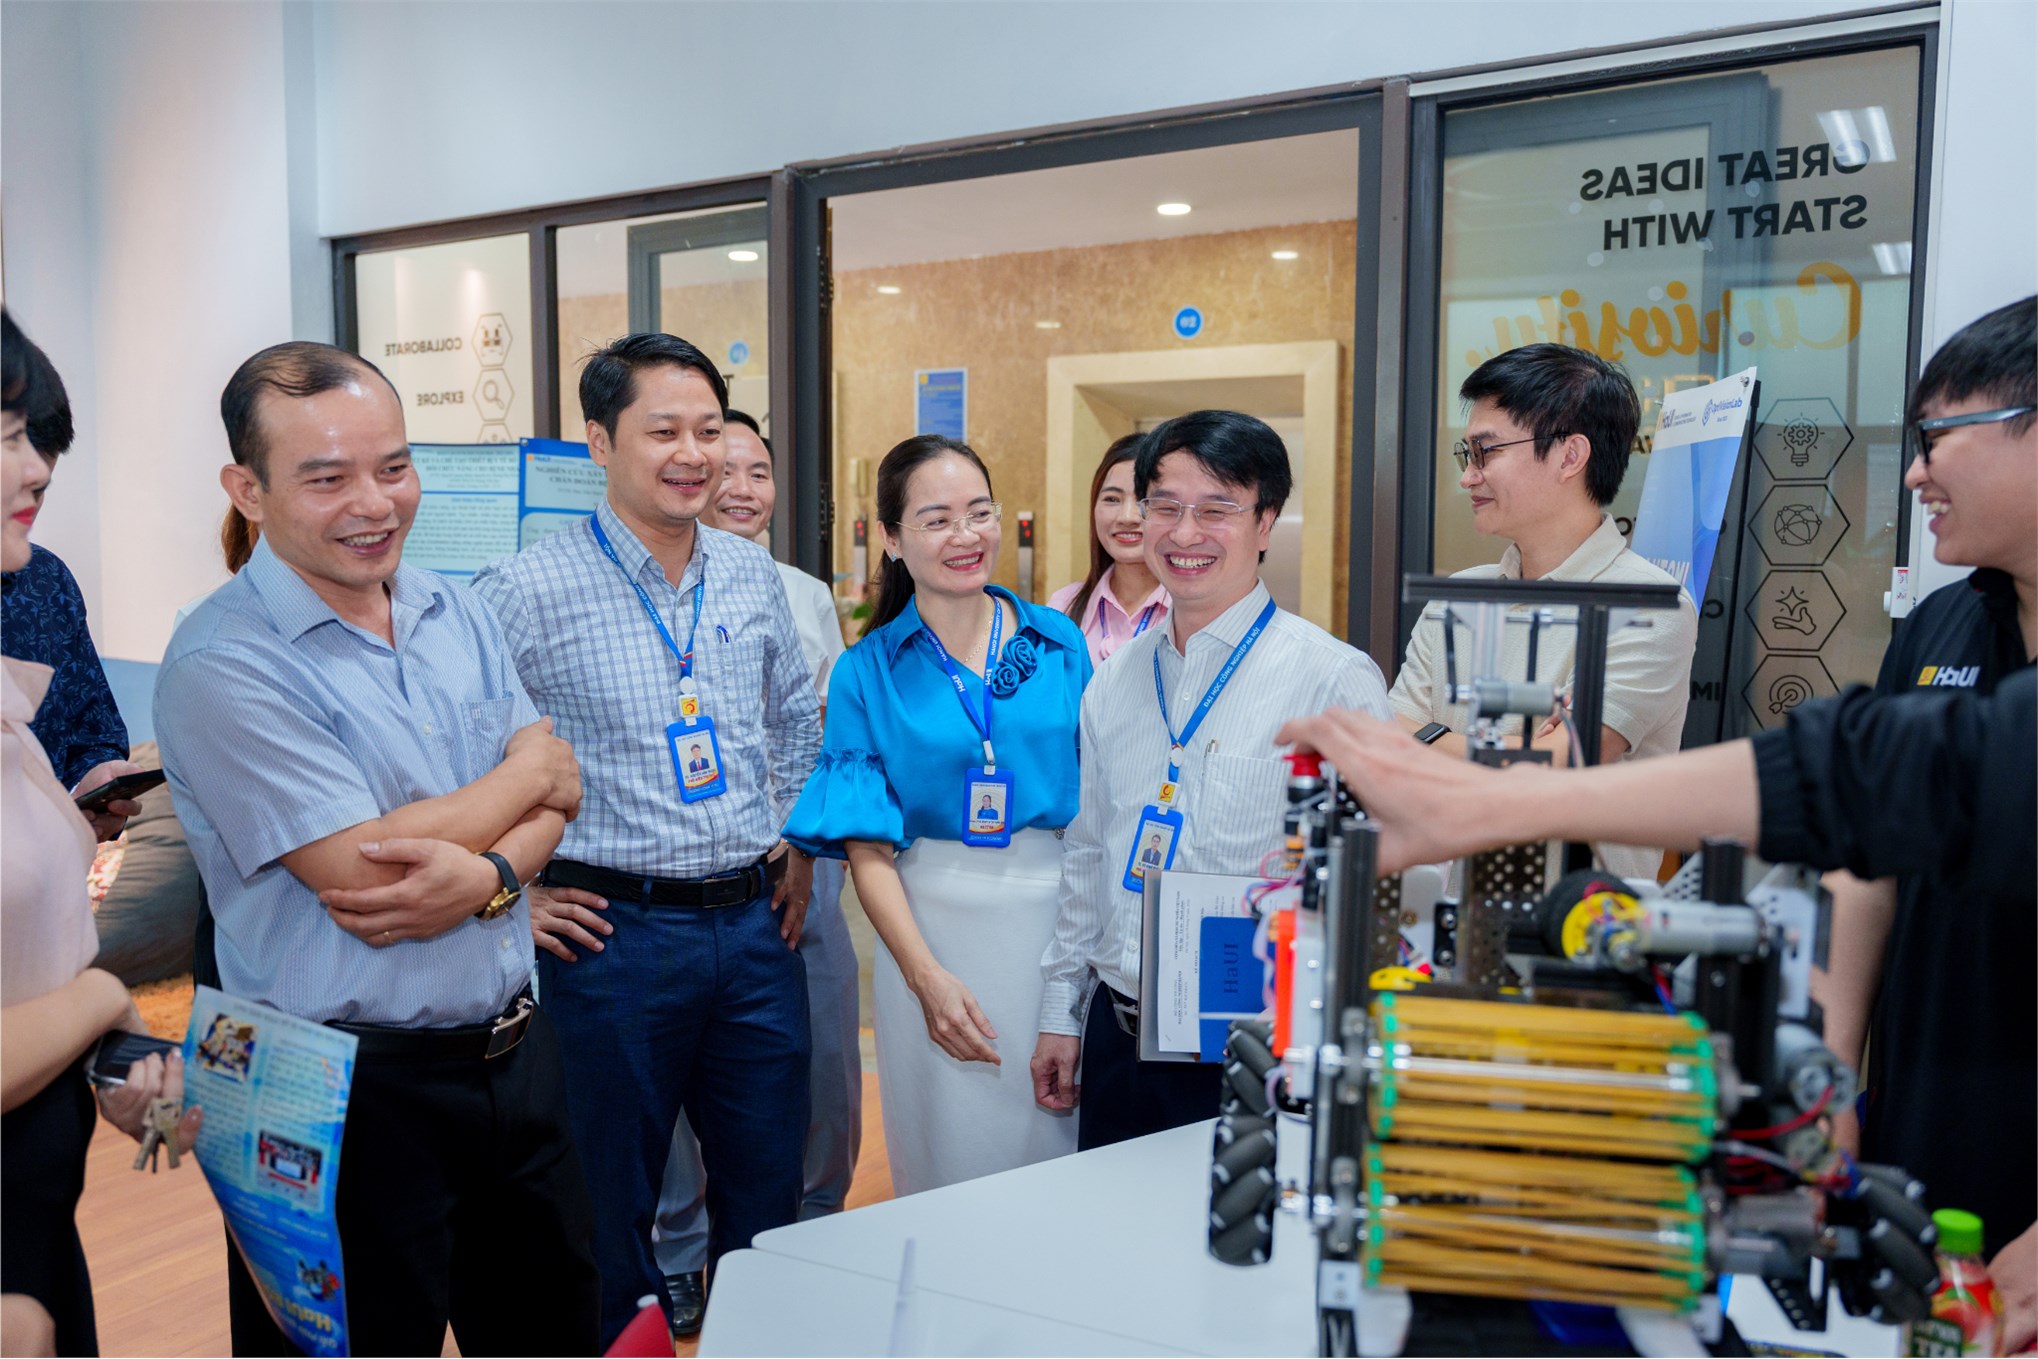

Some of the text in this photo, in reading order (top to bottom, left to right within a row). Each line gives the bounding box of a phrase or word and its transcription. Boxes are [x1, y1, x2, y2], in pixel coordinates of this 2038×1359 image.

[951, 674, 966, 693] HaUI
[1203, 626, 1261, 708] ĐẠI HỌC CÔNG NGHIỆP HÀ NỘI
[1932, 665, 1981, 687] HaUI
[1223, 943, 1239, 993] HaUI
